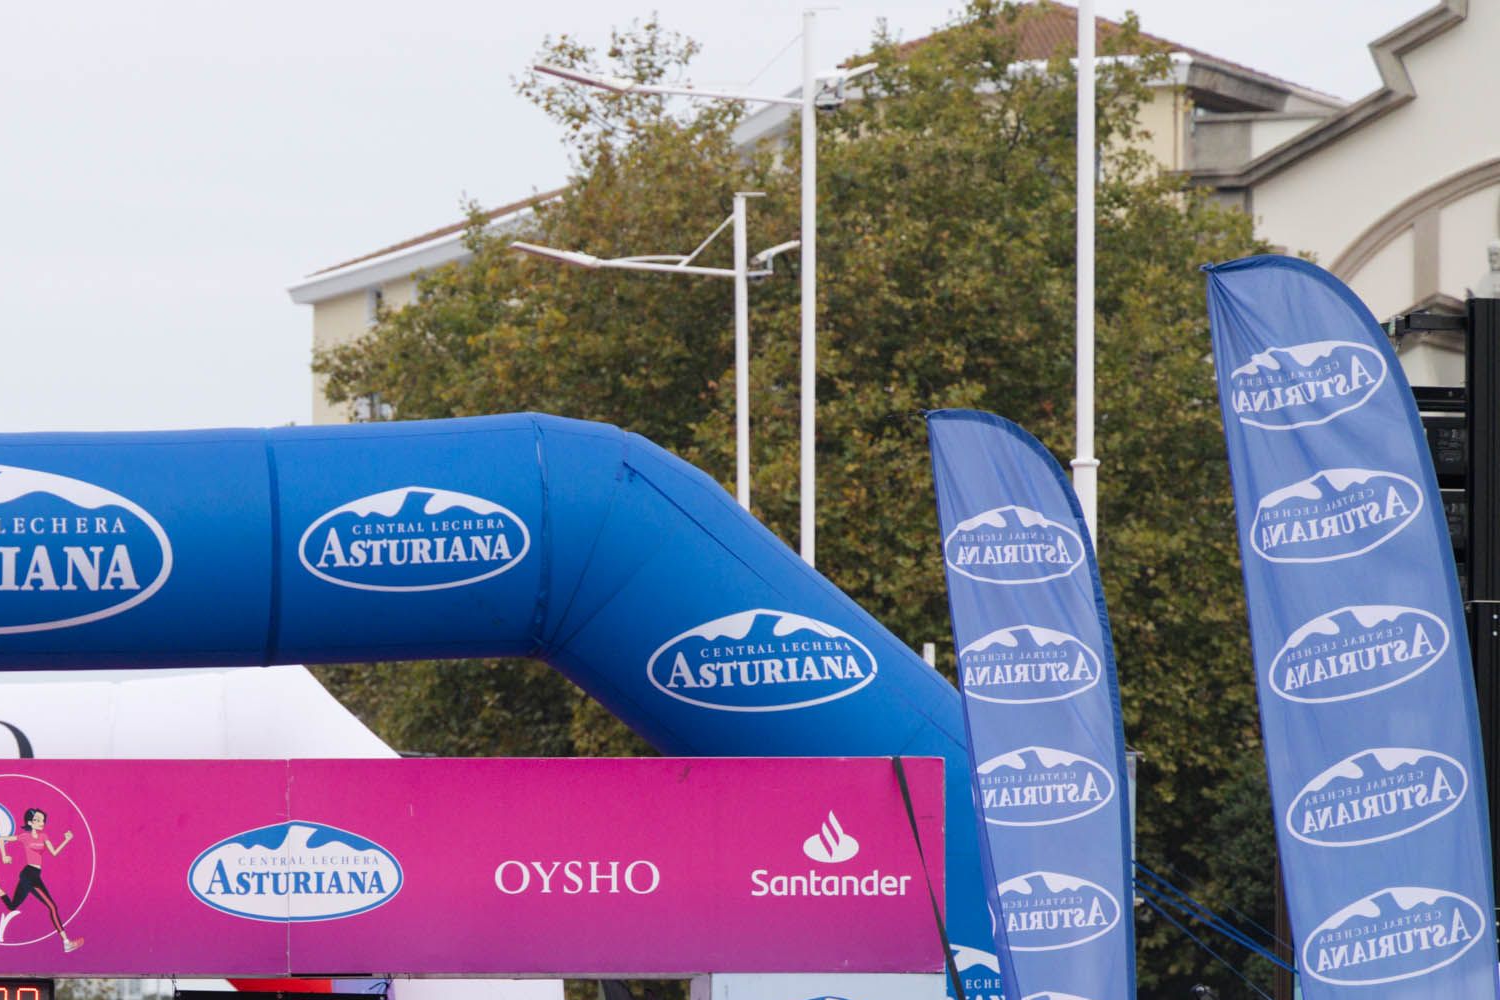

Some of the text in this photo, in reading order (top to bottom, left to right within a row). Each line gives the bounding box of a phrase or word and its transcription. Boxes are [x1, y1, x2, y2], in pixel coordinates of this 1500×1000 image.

[351, 517, 505, 535] CENTRAL LECHERA
[316, 519, 512, 568] ASTURIANA
[699, 640, 853, 661] CENTRAL LECHERA
[666, 650, 863, 688] ASTURIANA
[206, 857, 383, 896] ASTURIANA
[238, 855, 380, 867] CENTRAL LECHERA
[495, 859, 660, 895] OYSHO
[751, 869, 911, 898] Santander
